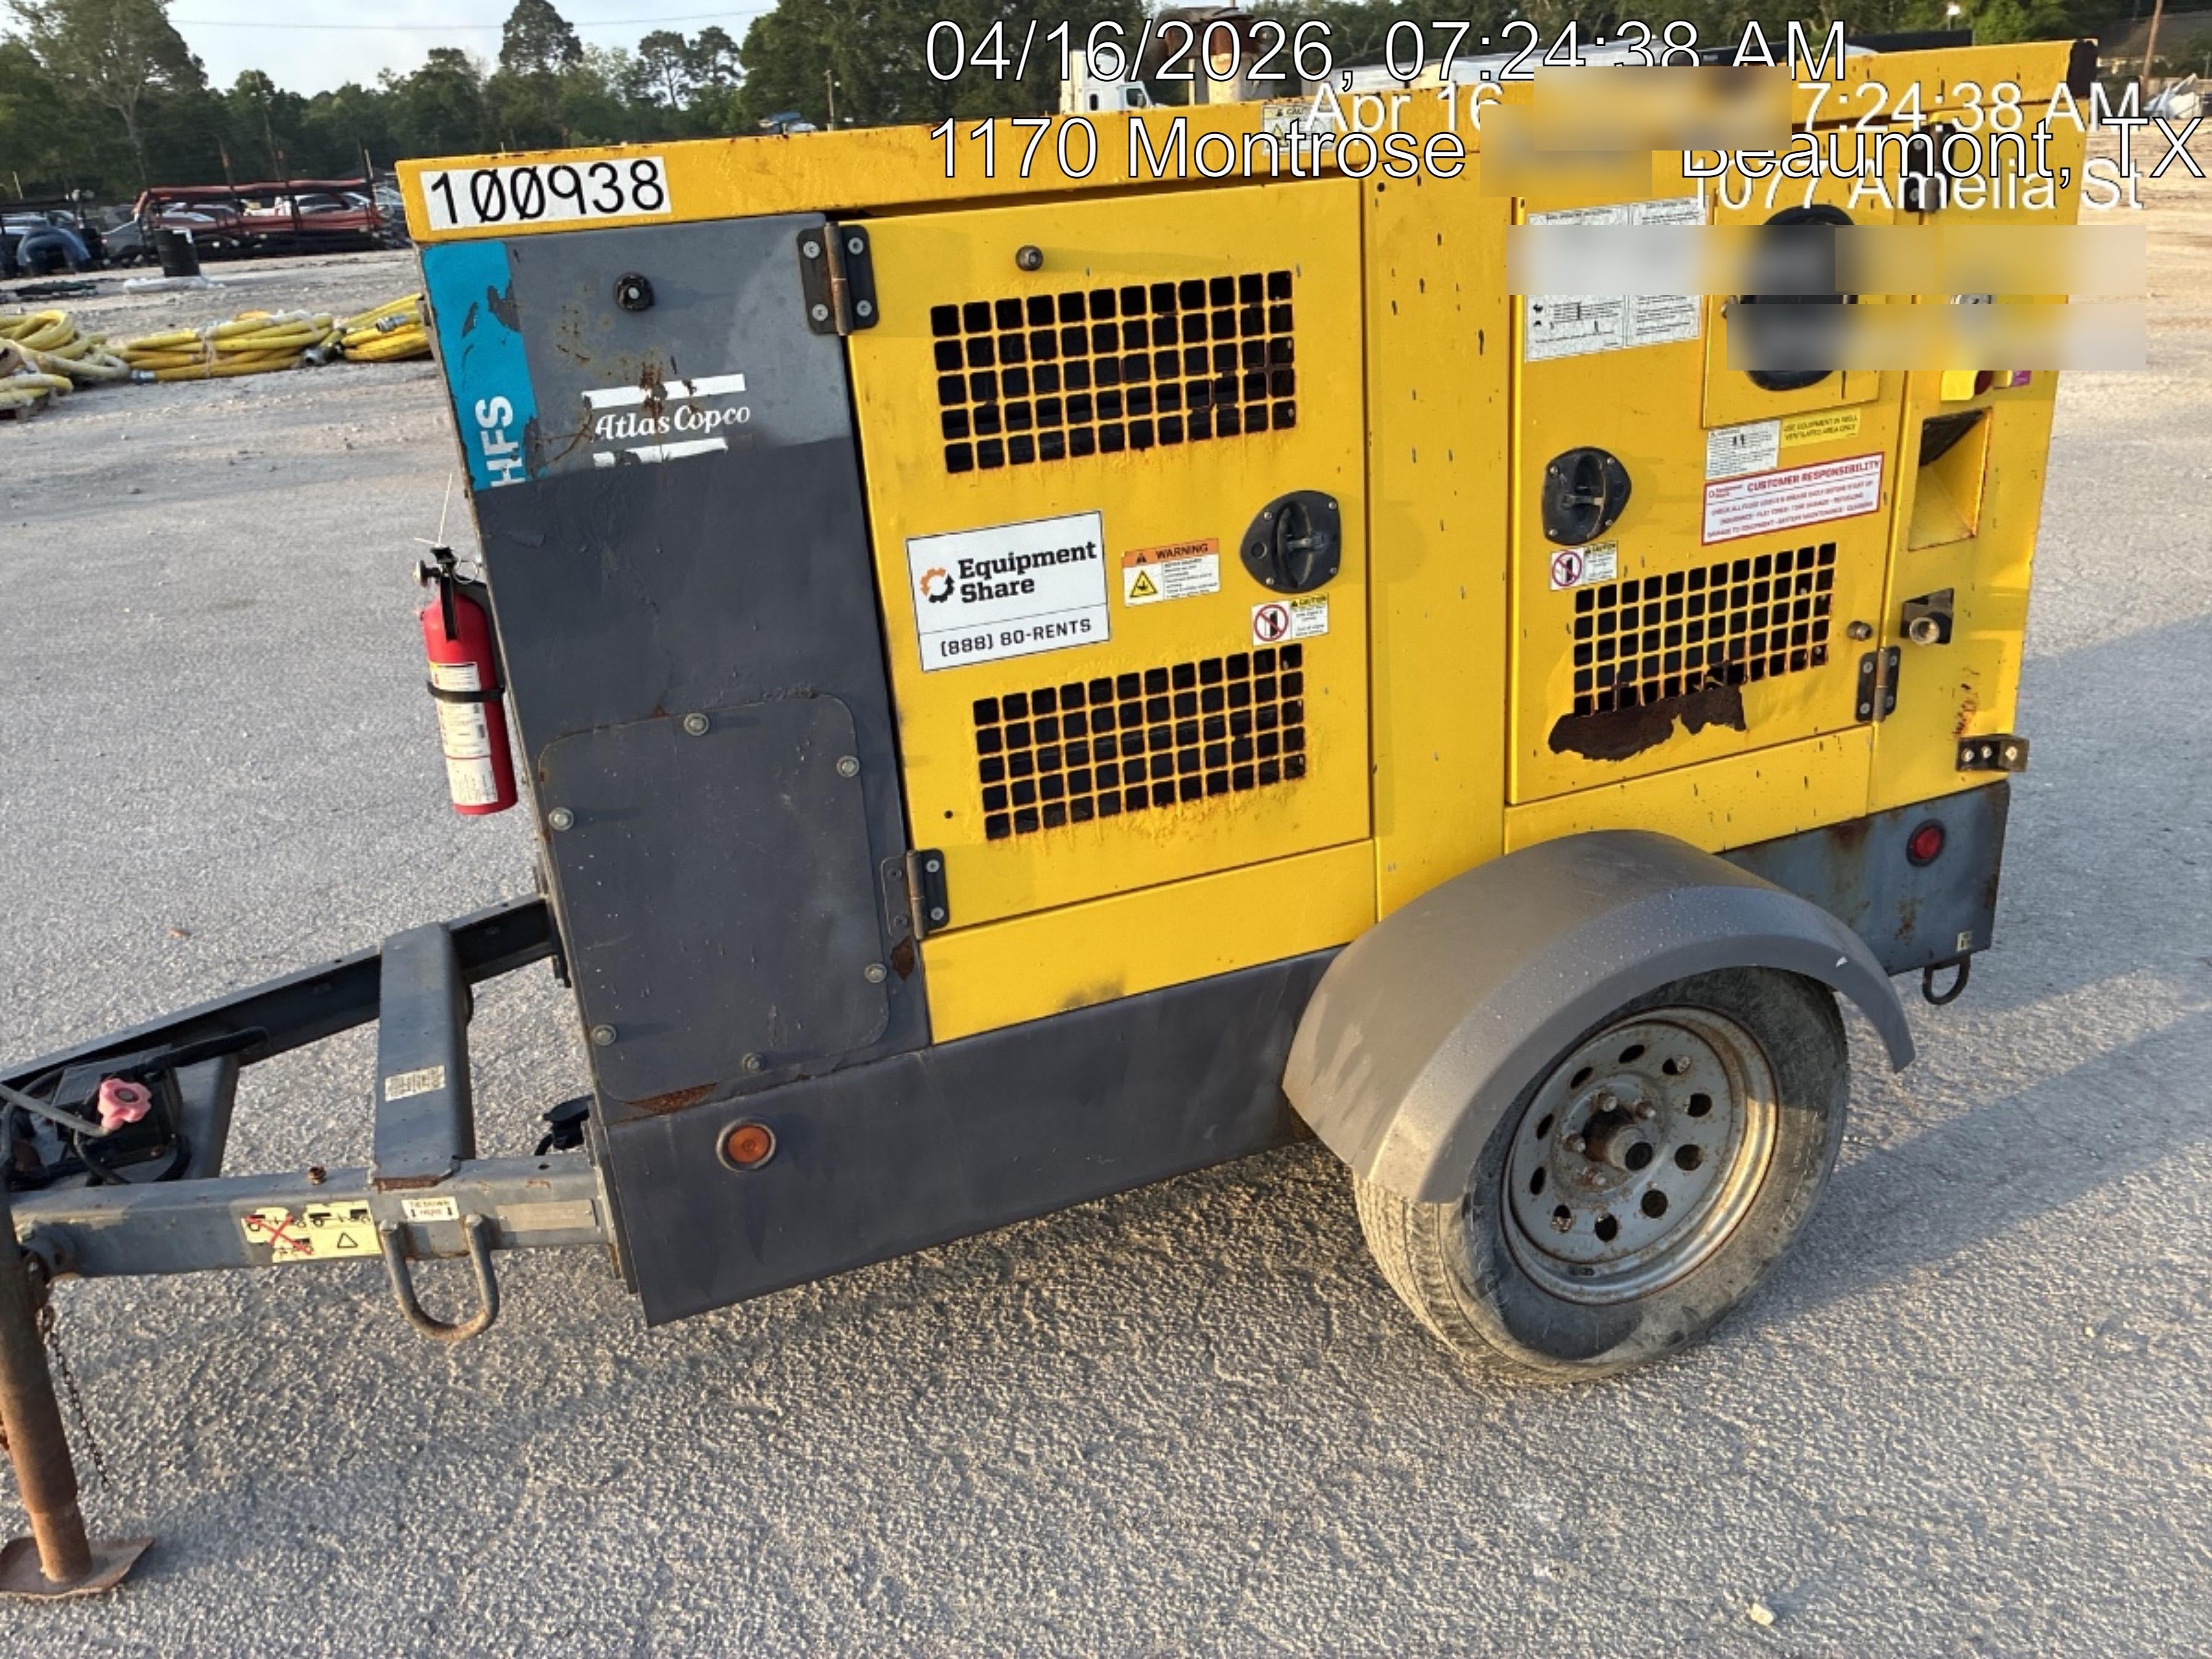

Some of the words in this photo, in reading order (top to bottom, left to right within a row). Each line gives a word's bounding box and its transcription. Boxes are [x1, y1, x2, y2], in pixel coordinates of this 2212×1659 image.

[431, 159, 664, 224] 100938
[475, 395, 527, 488] HFS
[594, 410, 670, 441] Atlas
[673, 404, 751, 434] Copco
[1747, 474, 1800, 492] CUSTOMER
[1801, 460, 1880, 482] RESPONSIBILITY
[958, 541, 1097, 581] Equipment
[1156, 543, 1209, 560] WARNING
[960, 578, 1035, 603] Share
[940, 633, 994, 657] (888)
[1000, 618, 1091, 646] 80-RENTS
